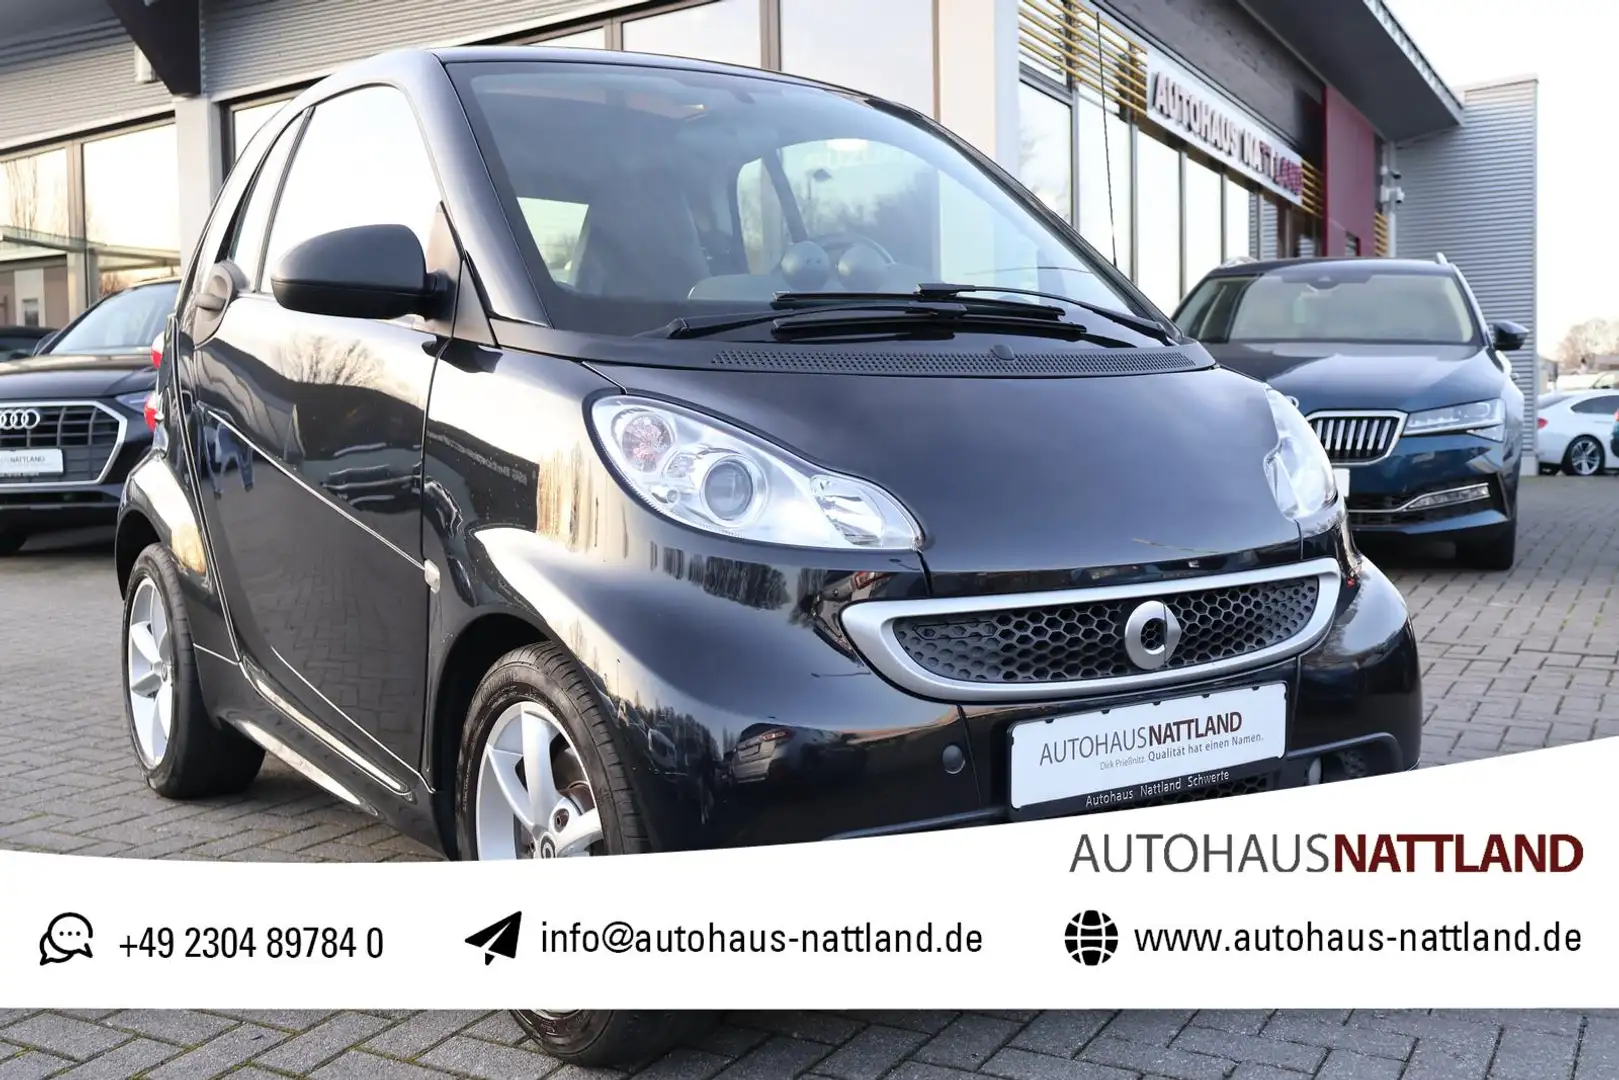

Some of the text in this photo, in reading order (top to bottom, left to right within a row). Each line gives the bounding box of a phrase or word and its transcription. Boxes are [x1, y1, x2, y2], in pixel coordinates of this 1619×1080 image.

[1153, 71, 1238, 157] AUTOHAUS
[1148, 746, 1186, 762] Qualität
[1188, 743, 1203, 755] hat
[1205, 739, 1230, 752] einen
[1231, 733, 1264, 747] Namen.
[1085, 770, 1230, 808] Autohaus Nattland Schwerte
